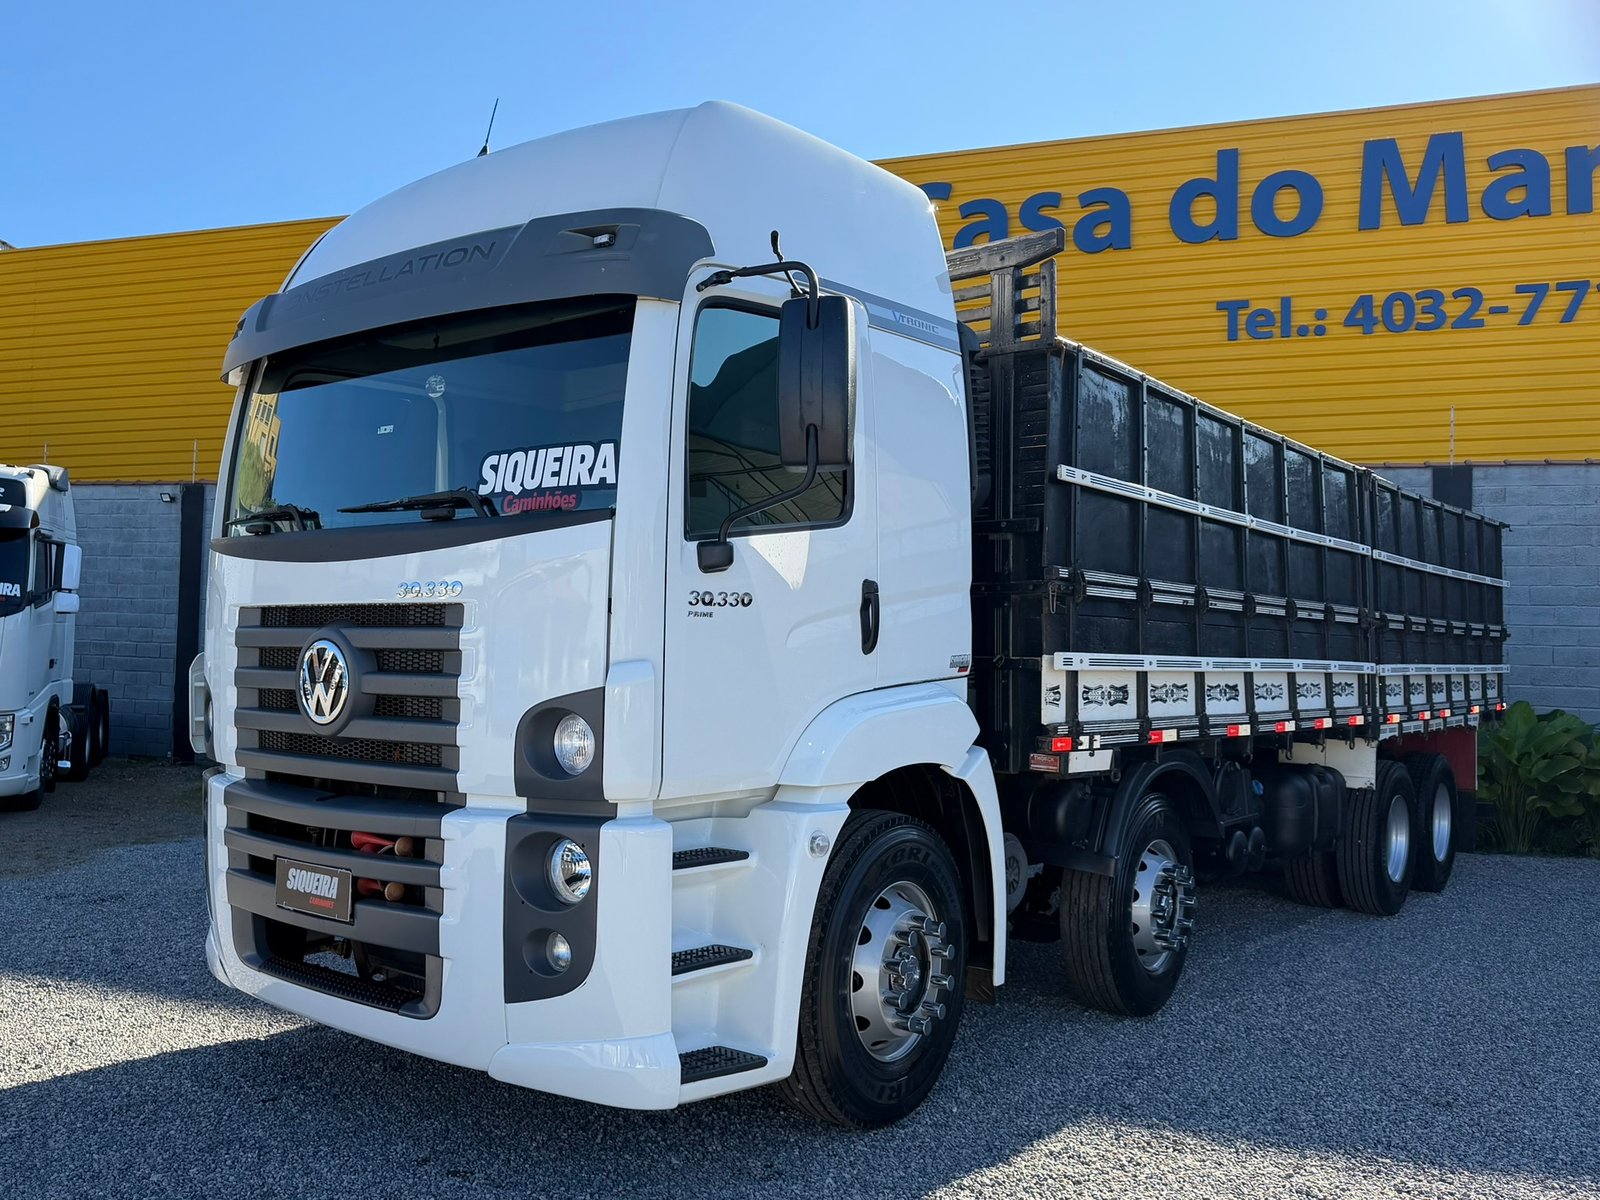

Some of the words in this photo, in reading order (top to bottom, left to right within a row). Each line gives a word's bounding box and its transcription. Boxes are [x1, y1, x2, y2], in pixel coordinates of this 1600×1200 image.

[1169, 148, 1324, 244] do
[1216, 296, 1328, 341] Tel.:
[1343, 280, 1600, 335] 4032-77
[478, 443, 617, 495] SIQUEIRA
[503, 490, 577, 513] Caminhões
[396, 580, 464, 598] 30.330
[688, 590, 753, 607] 30.330
[687, 610, 714, 618] PRIME
[286, 868, 339, 899] SIQUEIRA
